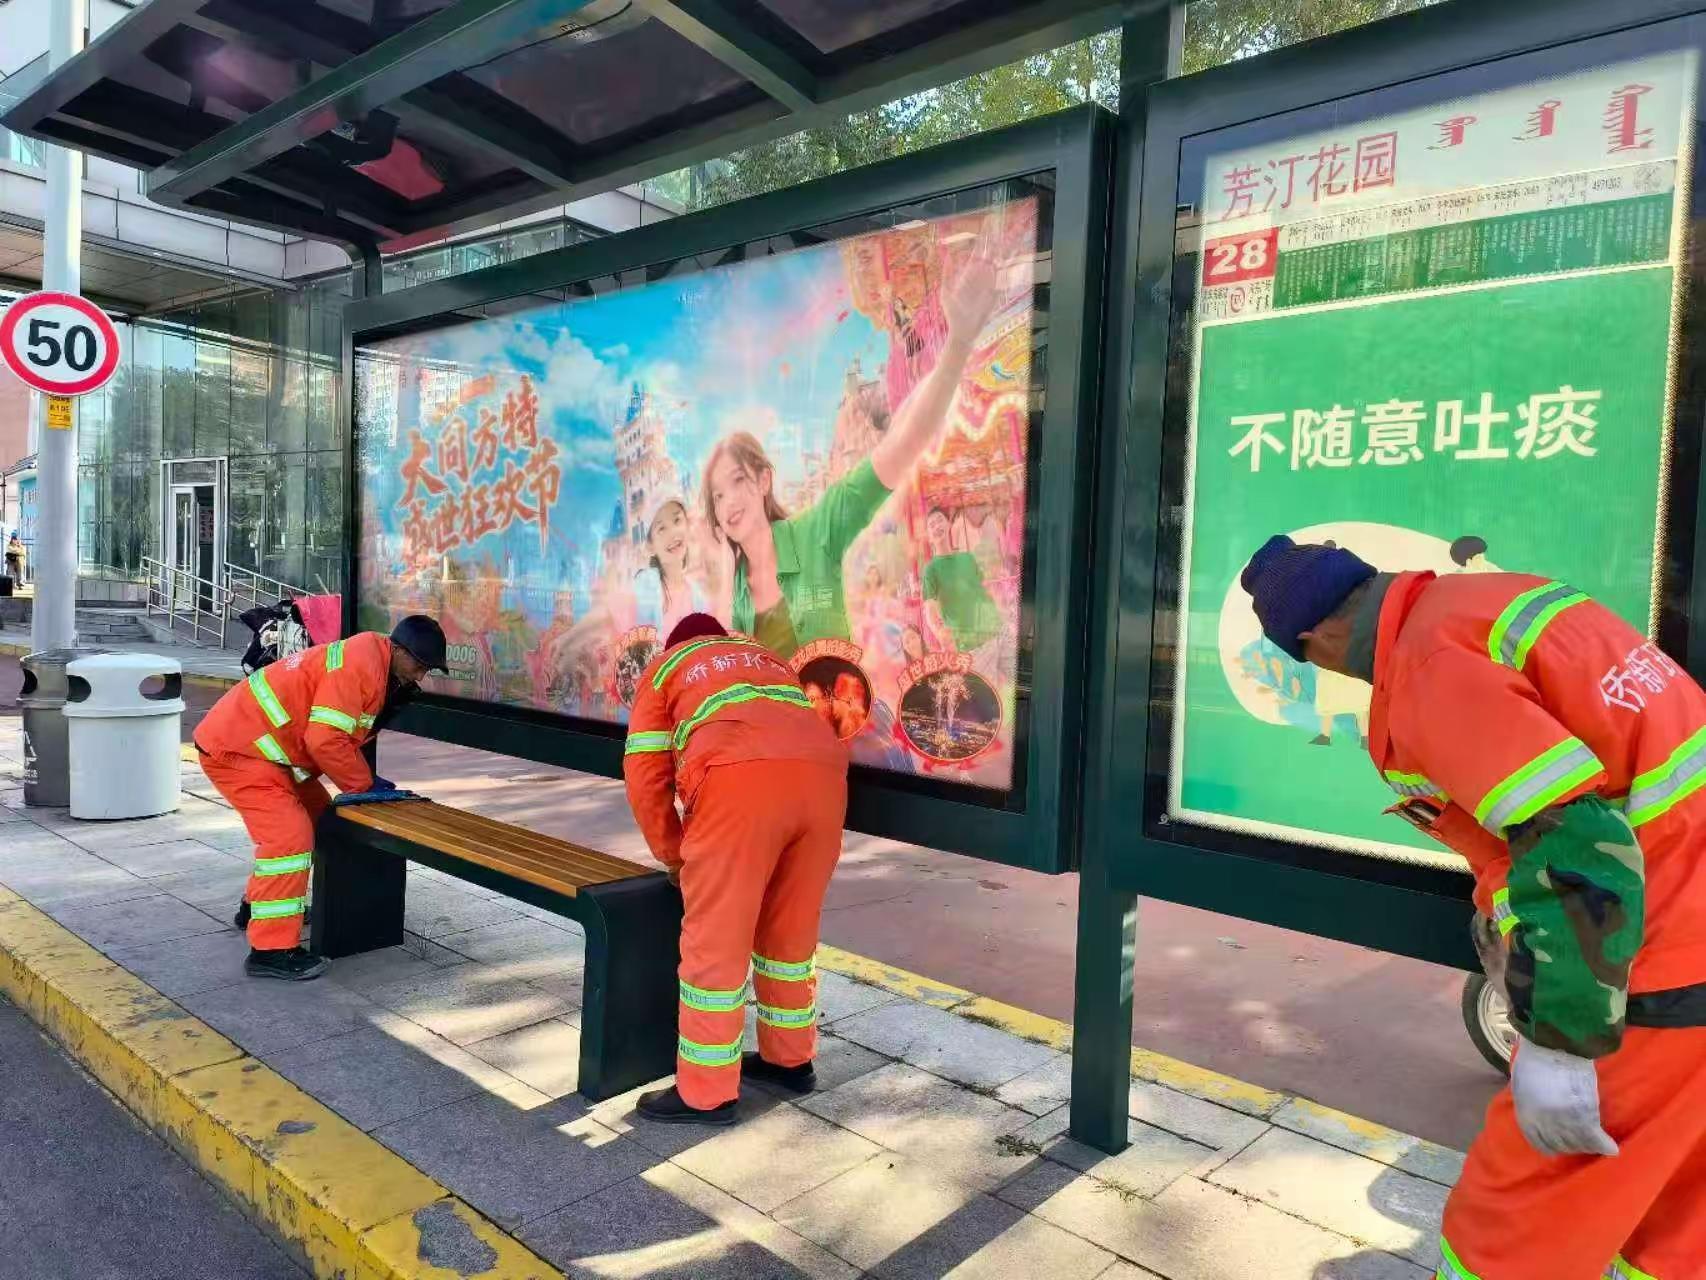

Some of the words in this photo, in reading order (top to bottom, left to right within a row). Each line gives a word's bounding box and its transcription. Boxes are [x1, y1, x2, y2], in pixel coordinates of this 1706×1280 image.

[1221, 131, 1398, 220] 芳汀花园
[1210, 238, 1267, 276] 28
[27, 317, 98, 372] 50
[397, 374, 538, 508] 大同方特
[1228, 384, 1603, 473] 不随意吐痰
[684, 652, 792, 684] 侨新环
